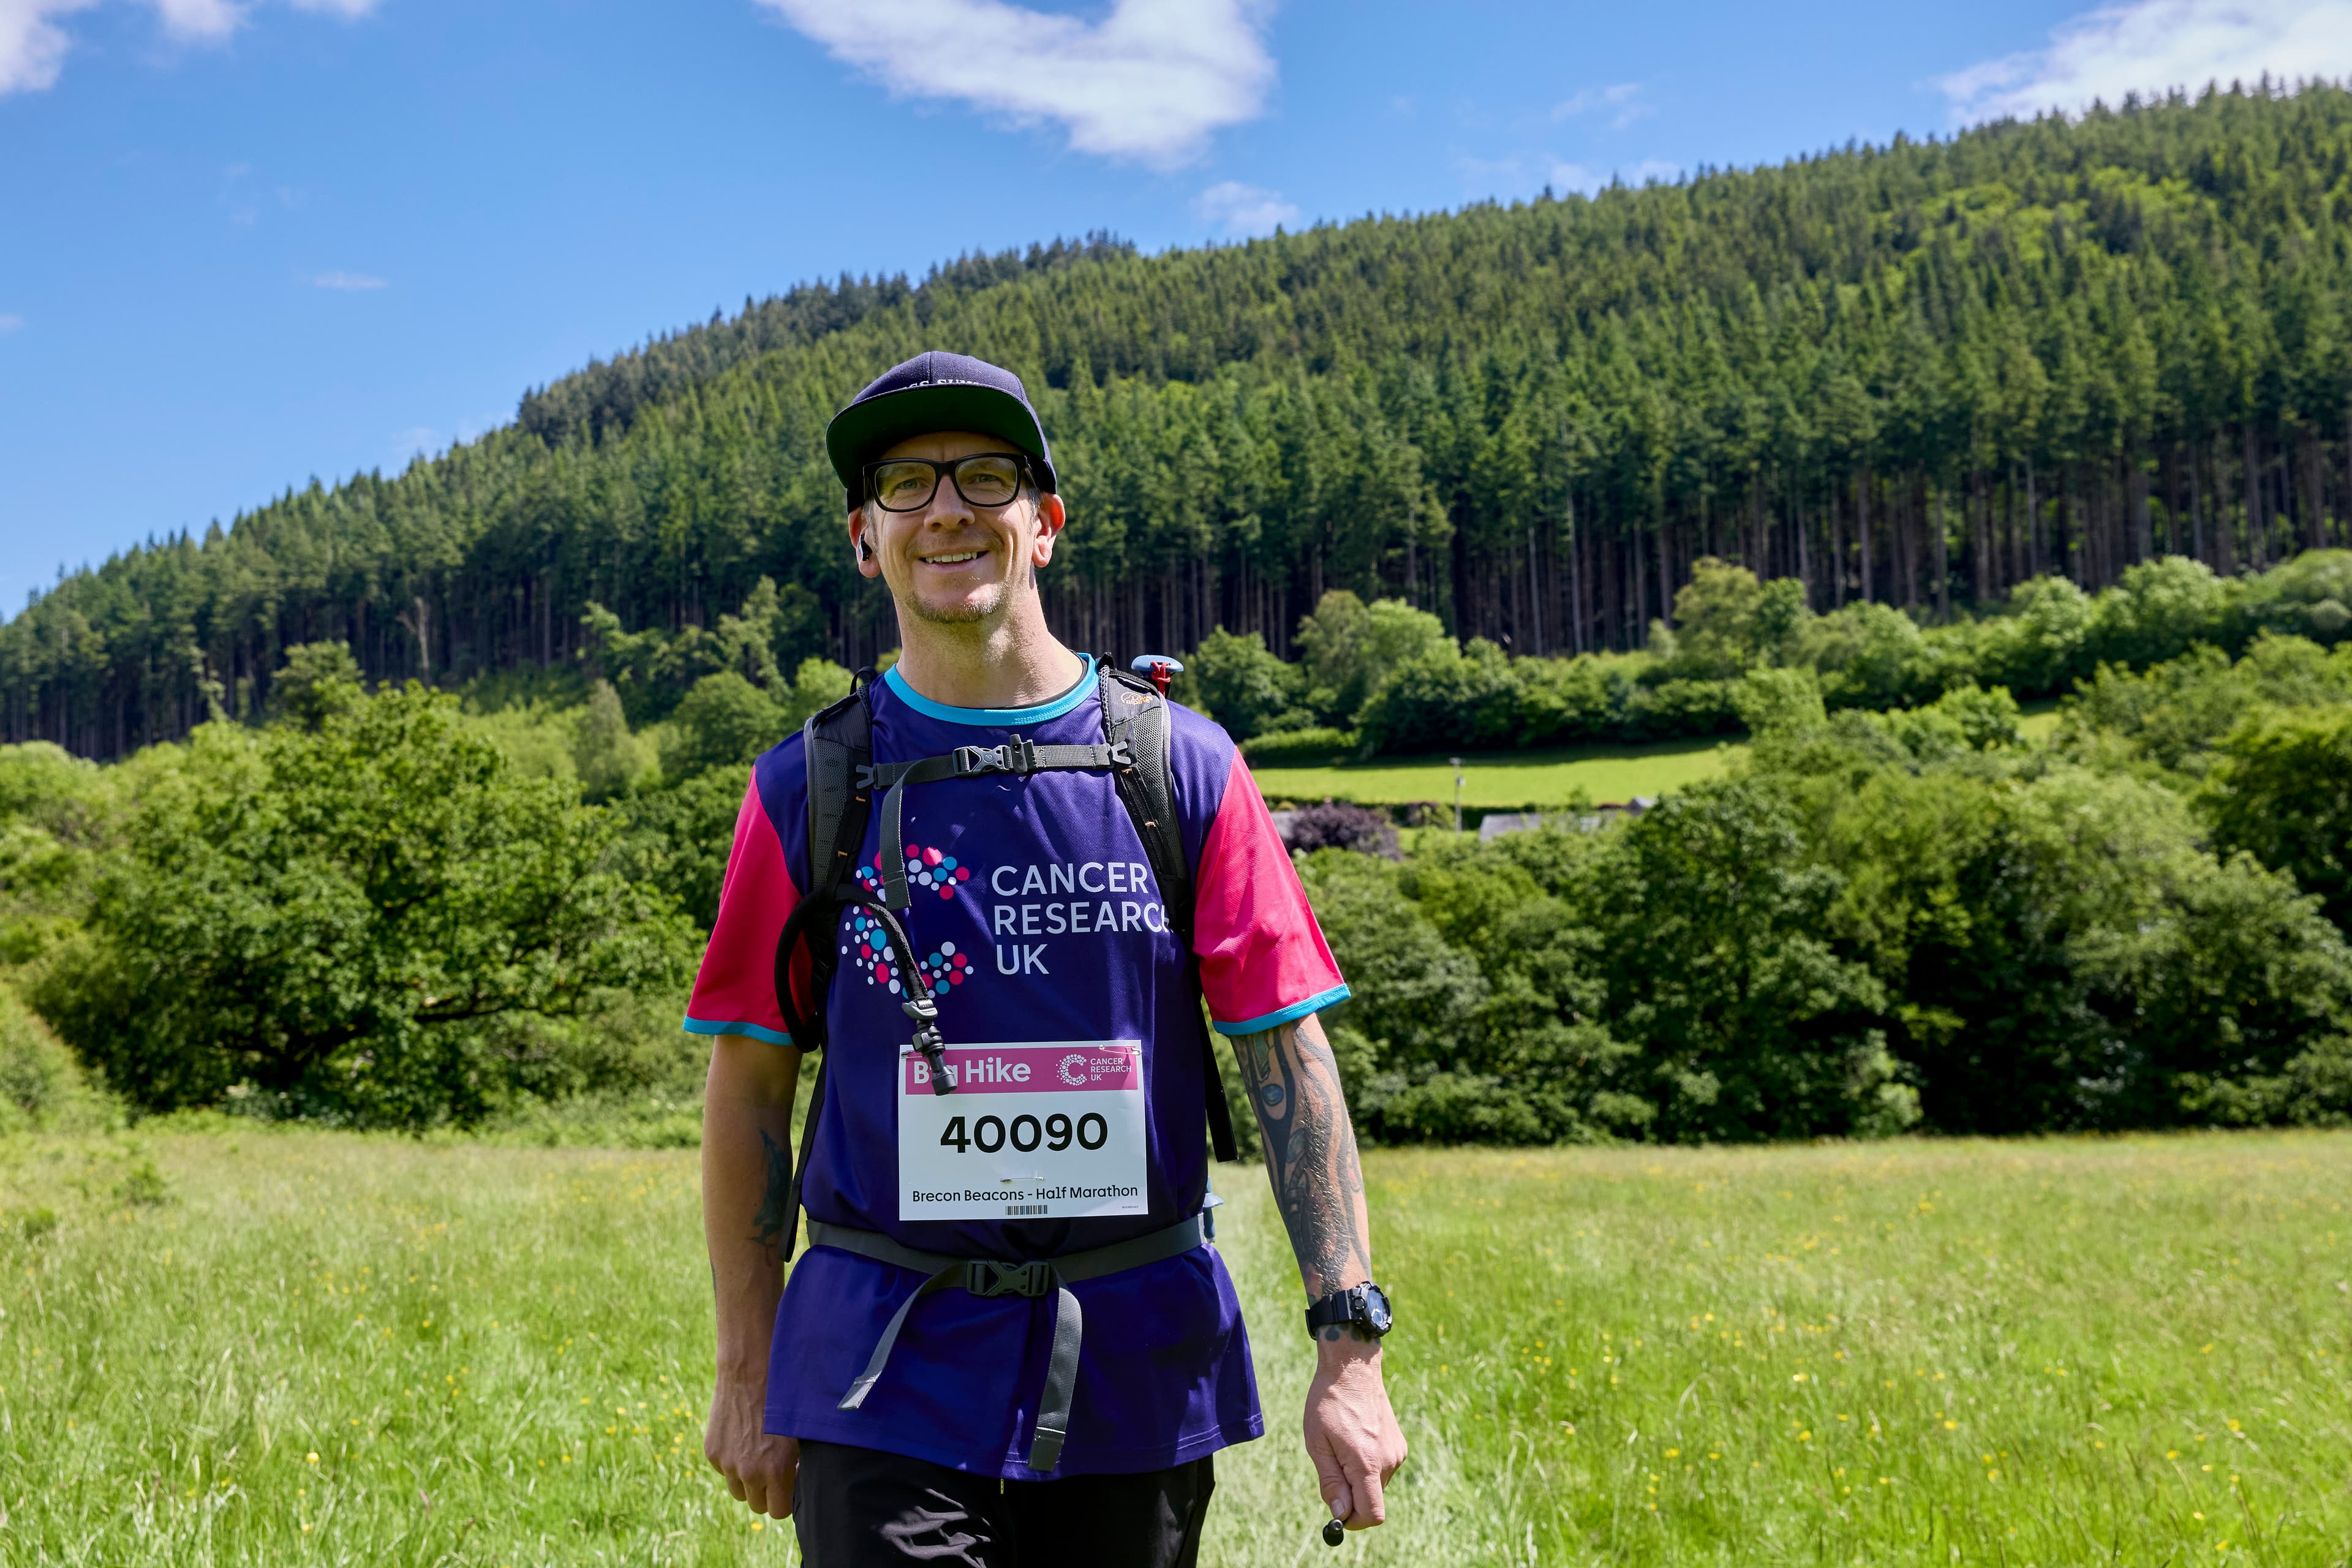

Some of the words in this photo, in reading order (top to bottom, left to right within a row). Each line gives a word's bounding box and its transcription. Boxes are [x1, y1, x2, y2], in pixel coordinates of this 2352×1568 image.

[991, 862, 1149, 897] CANCER
[996, 944, 1050, 975] UK
[965, 1057, 1031, 1083] Hike
[940, 1112, 1108, 1154] 40090
[913, 1190, 961, 1202] Brecon
[964, 1189, 1024, 1201] Beacons
[1036, 1186, 1067, 1199] Half
[1070, 1185, 1138, 1199] Marathon
